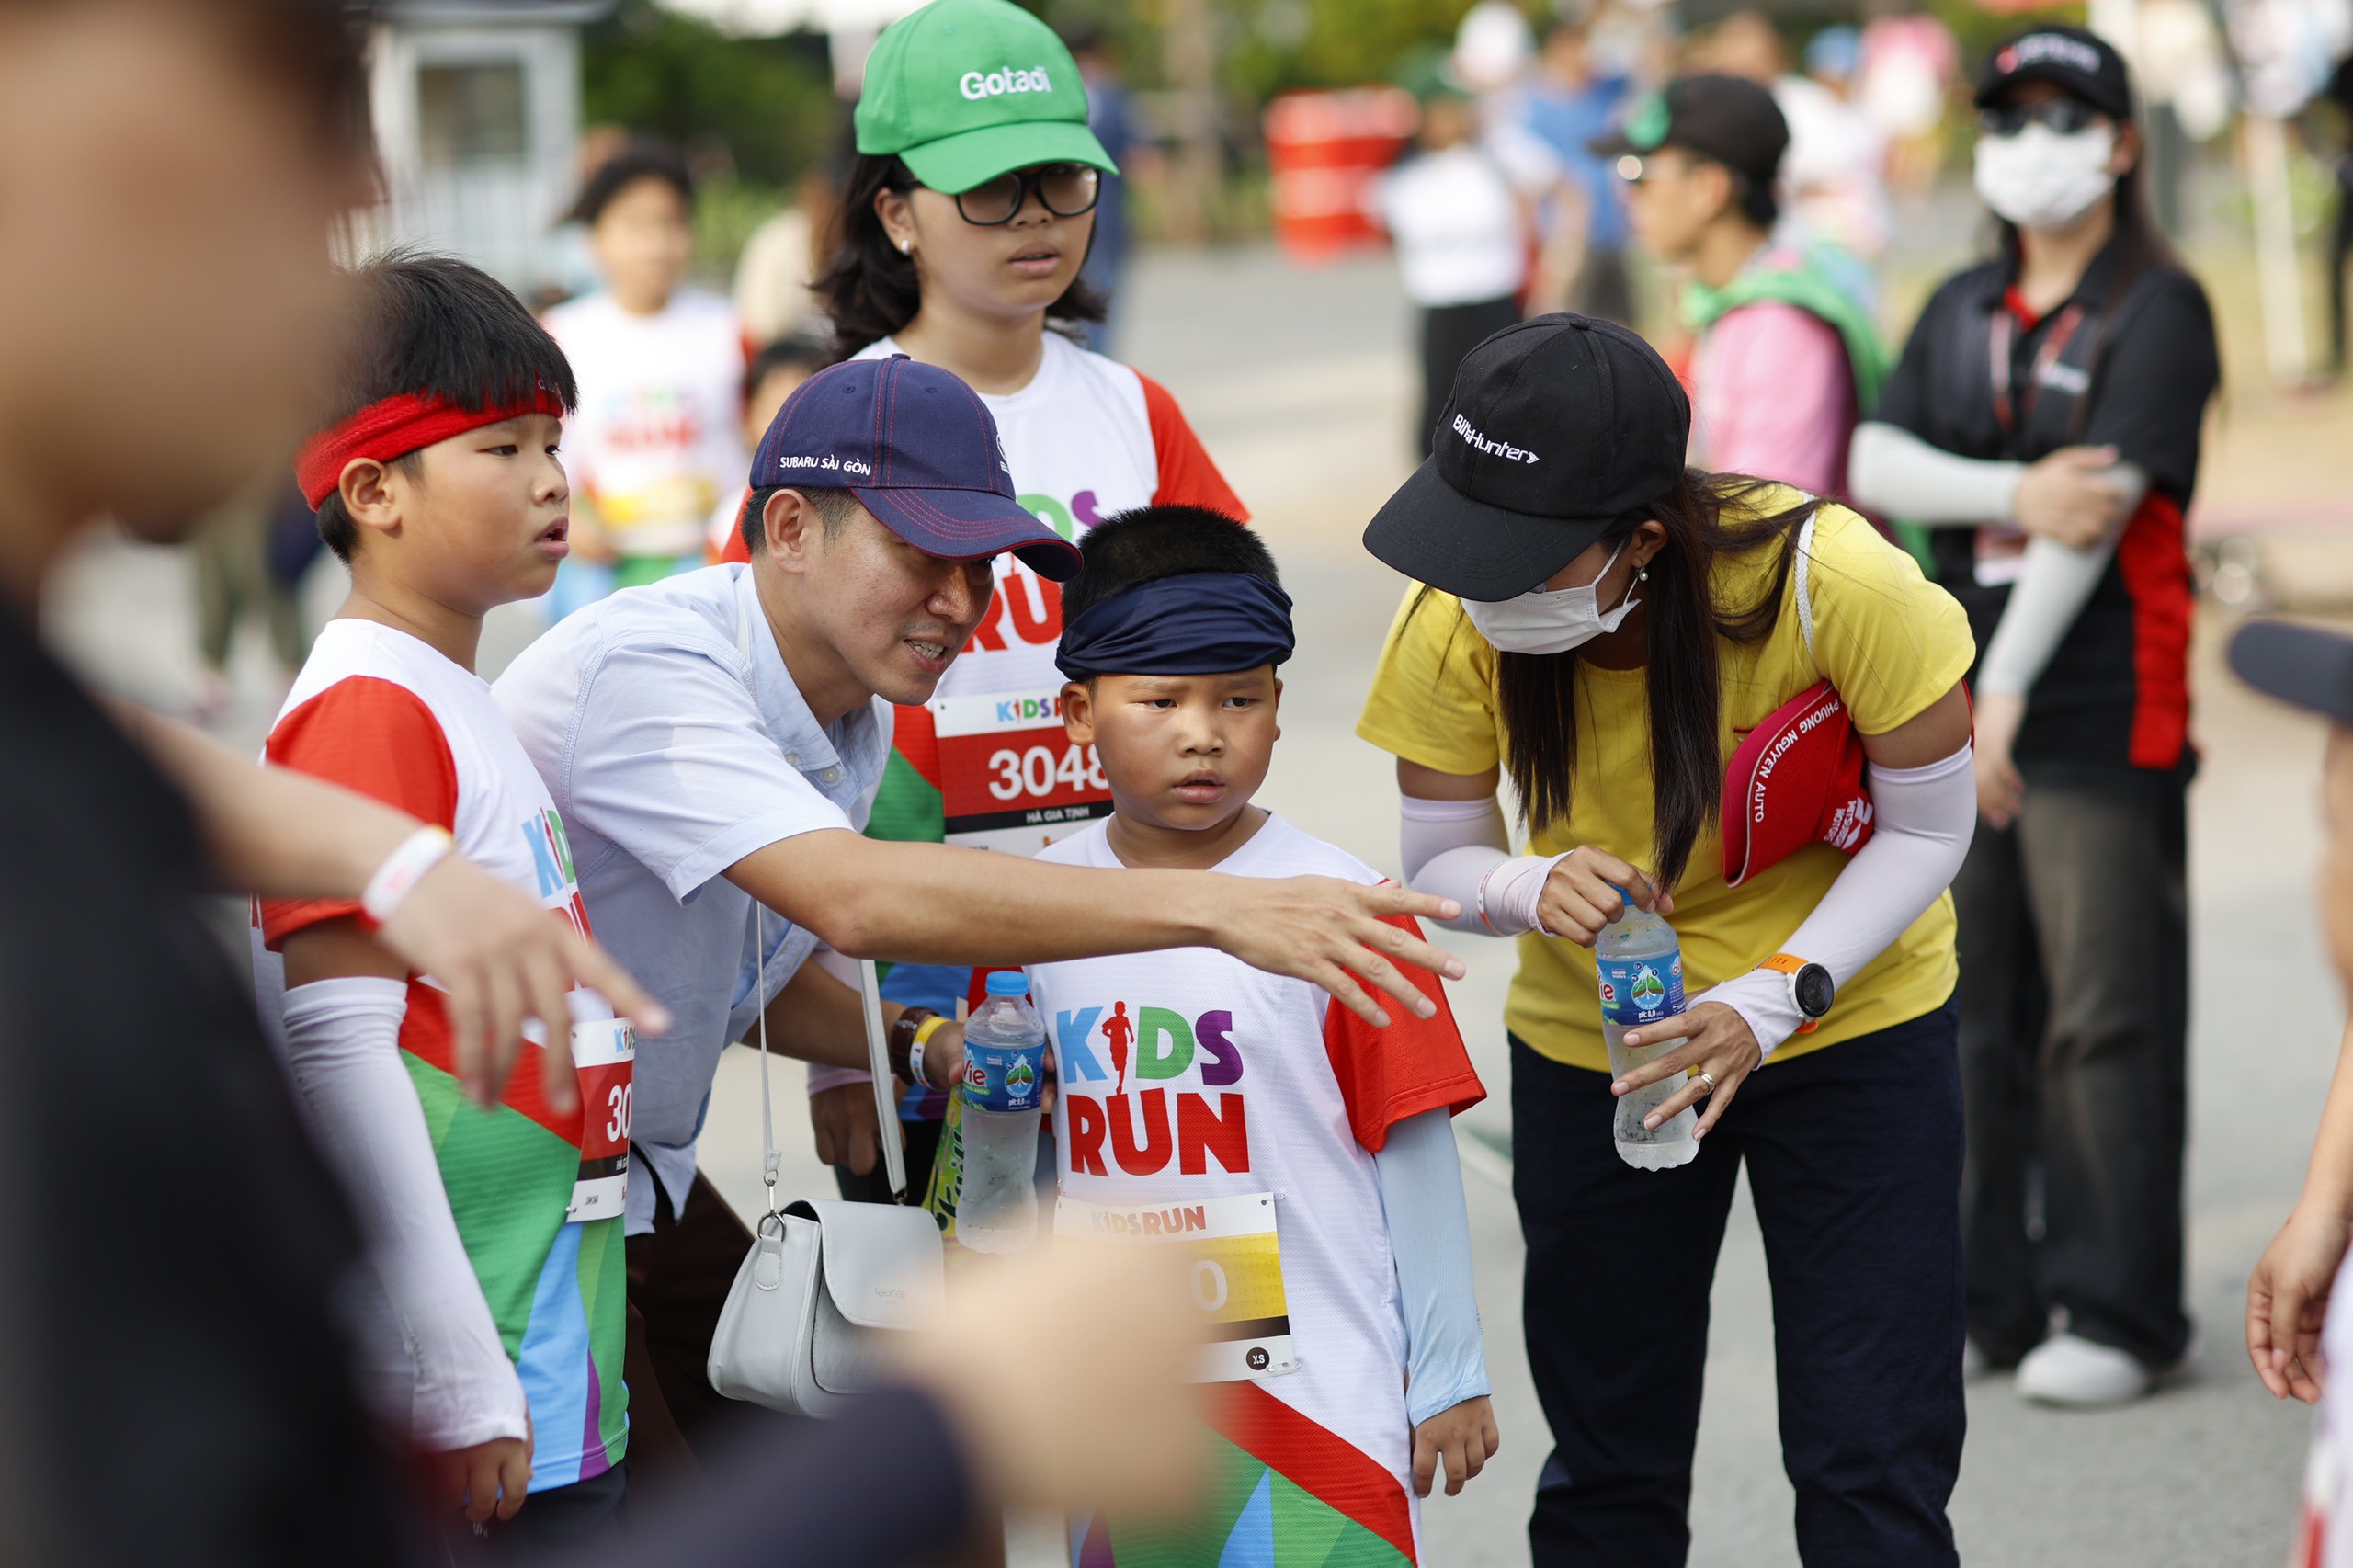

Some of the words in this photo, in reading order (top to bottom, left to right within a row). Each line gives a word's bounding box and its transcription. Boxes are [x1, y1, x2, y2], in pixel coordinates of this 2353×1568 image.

[959, 65, 1052, 101] Gotadi
[779, 456, 819, 468] SUBARU
[820, 453, 840, 471] SÀI
[843, 458, 871, 476] GÒN
[987, 743, 1111, 801] 3048
[1758, 729, 1799, 779] NGUYEN
[1754, 781, 1766, 823] AUTO
[1056, 1001, 1244, 1094] KIDS
[1066, 1088, 1250, 1177] RUN
[1252, 1354, 1265, 1365] XS
